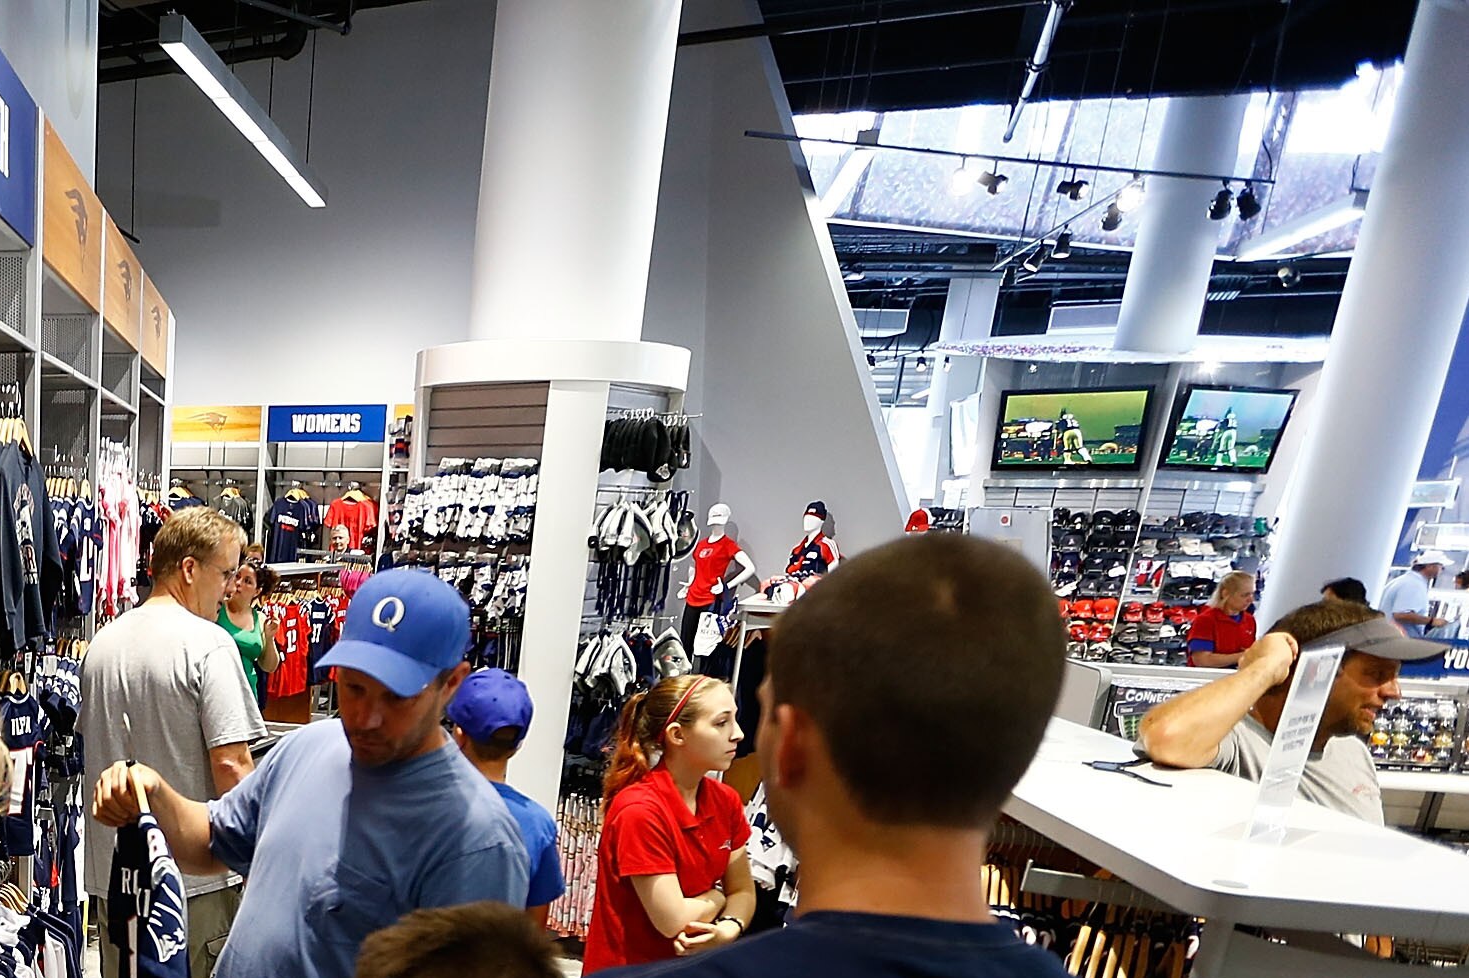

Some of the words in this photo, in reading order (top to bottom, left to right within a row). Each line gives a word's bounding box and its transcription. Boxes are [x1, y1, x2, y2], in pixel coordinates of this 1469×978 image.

[291, 412, 362, 434] WOMENS
[372, 596, 405, 633] Q
[1125, 688, 1179, 704] CONNEC
